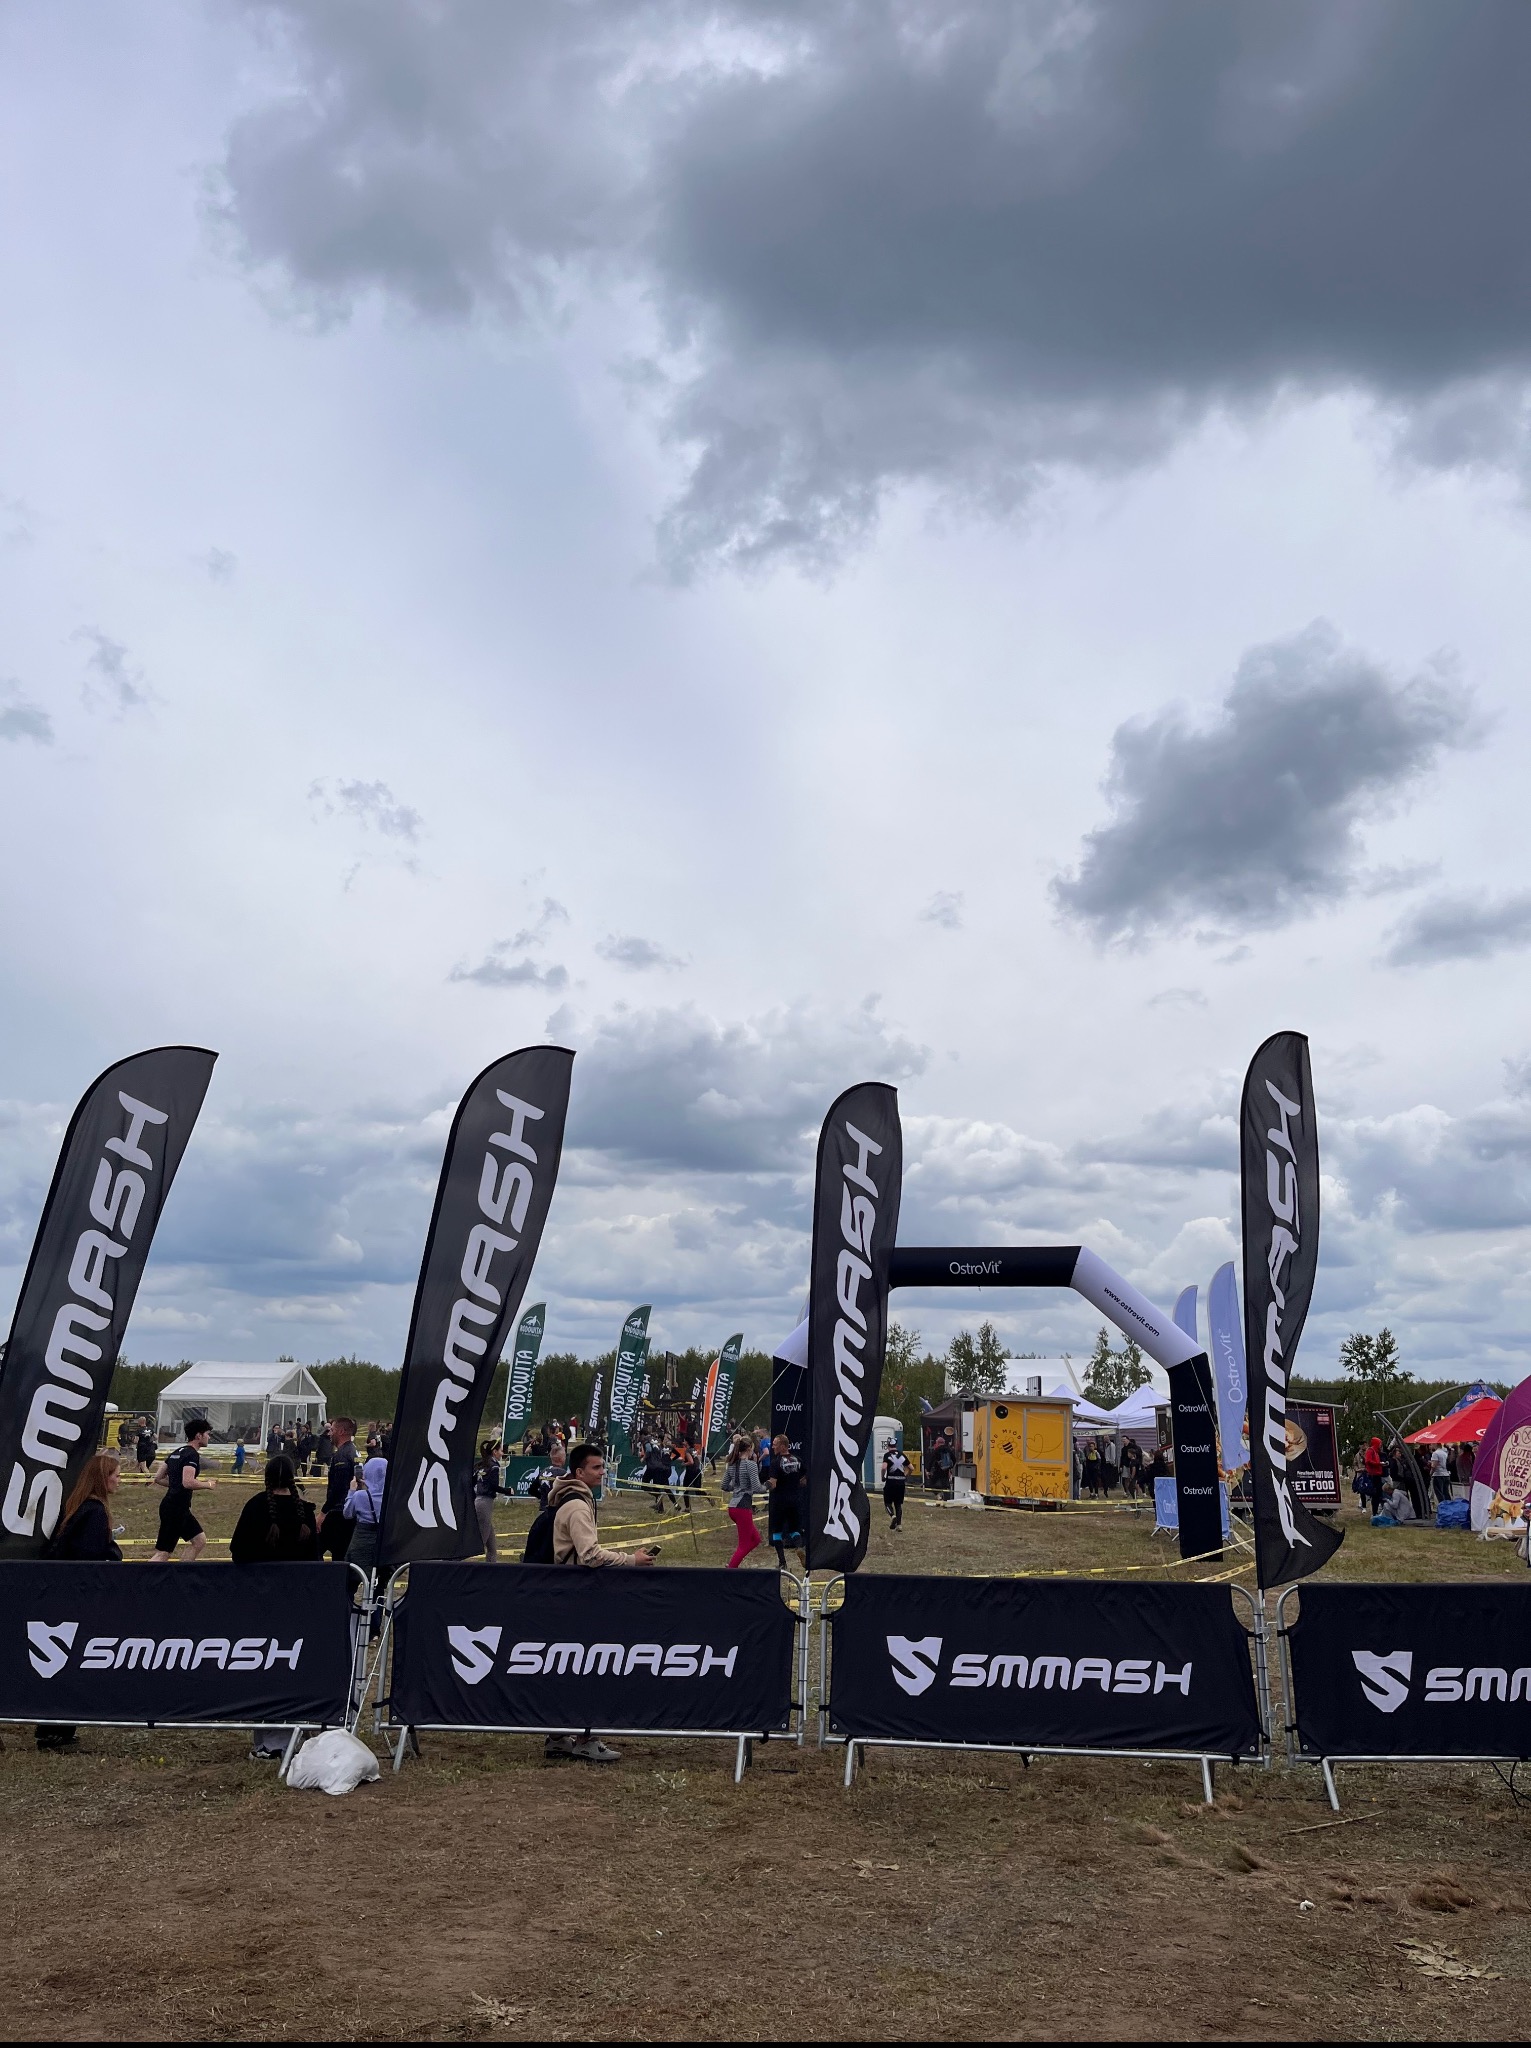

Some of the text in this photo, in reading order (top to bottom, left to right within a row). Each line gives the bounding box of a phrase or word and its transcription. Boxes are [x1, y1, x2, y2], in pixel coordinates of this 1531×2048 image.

[1, 1090, 169, 1540] SMMASH
[407, 1088, 546, 1531] SMMASH
[823, 1121, 883, 1547] SMMASH
[1103, 1286, 1160, 1337] www.ostrovit.com
[507, 1350, 533, 1420] RODOWITA
[589, 1372, 604, 1429] SMMASH
[611, 1350, 636, 1422] RODOWITA
[711, 1372, 730, 1433] RODOWITA
[79, 1637, 304, 1671] SMMASH
[506, 1641, 739, 1678] SMMASH
[949, 1653, 1193, 1696] SMMASH
